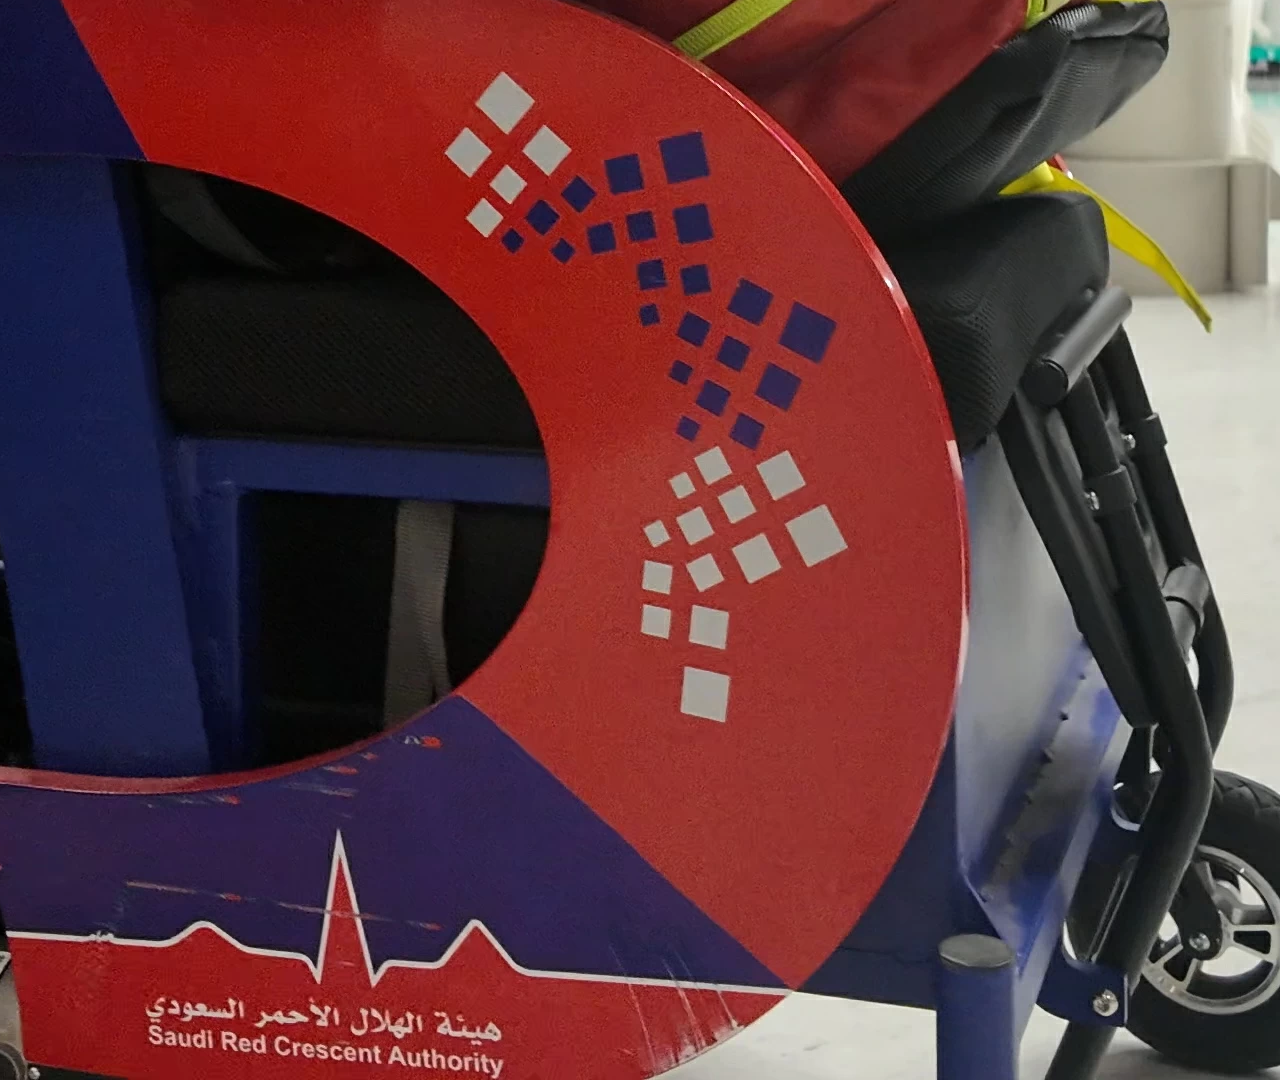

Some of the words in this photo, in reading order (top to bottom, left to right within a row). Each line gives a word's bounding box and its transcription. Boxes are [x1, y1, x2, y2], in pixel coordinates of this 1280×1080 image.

[145, 996, 245, 1024] السعودي
[254, 996, 341, 1029] الأحمر
[350, 1007, 423, 1039] الهلال
[433, 1011, 503, 1046] هيئة
[148, 1024, 214, 1050] Saudi
[221, 1030, 268, 1055] Red
[273, 1035, 383, 1065] Crescent
[387, 1045, 505, 1080] Authority
